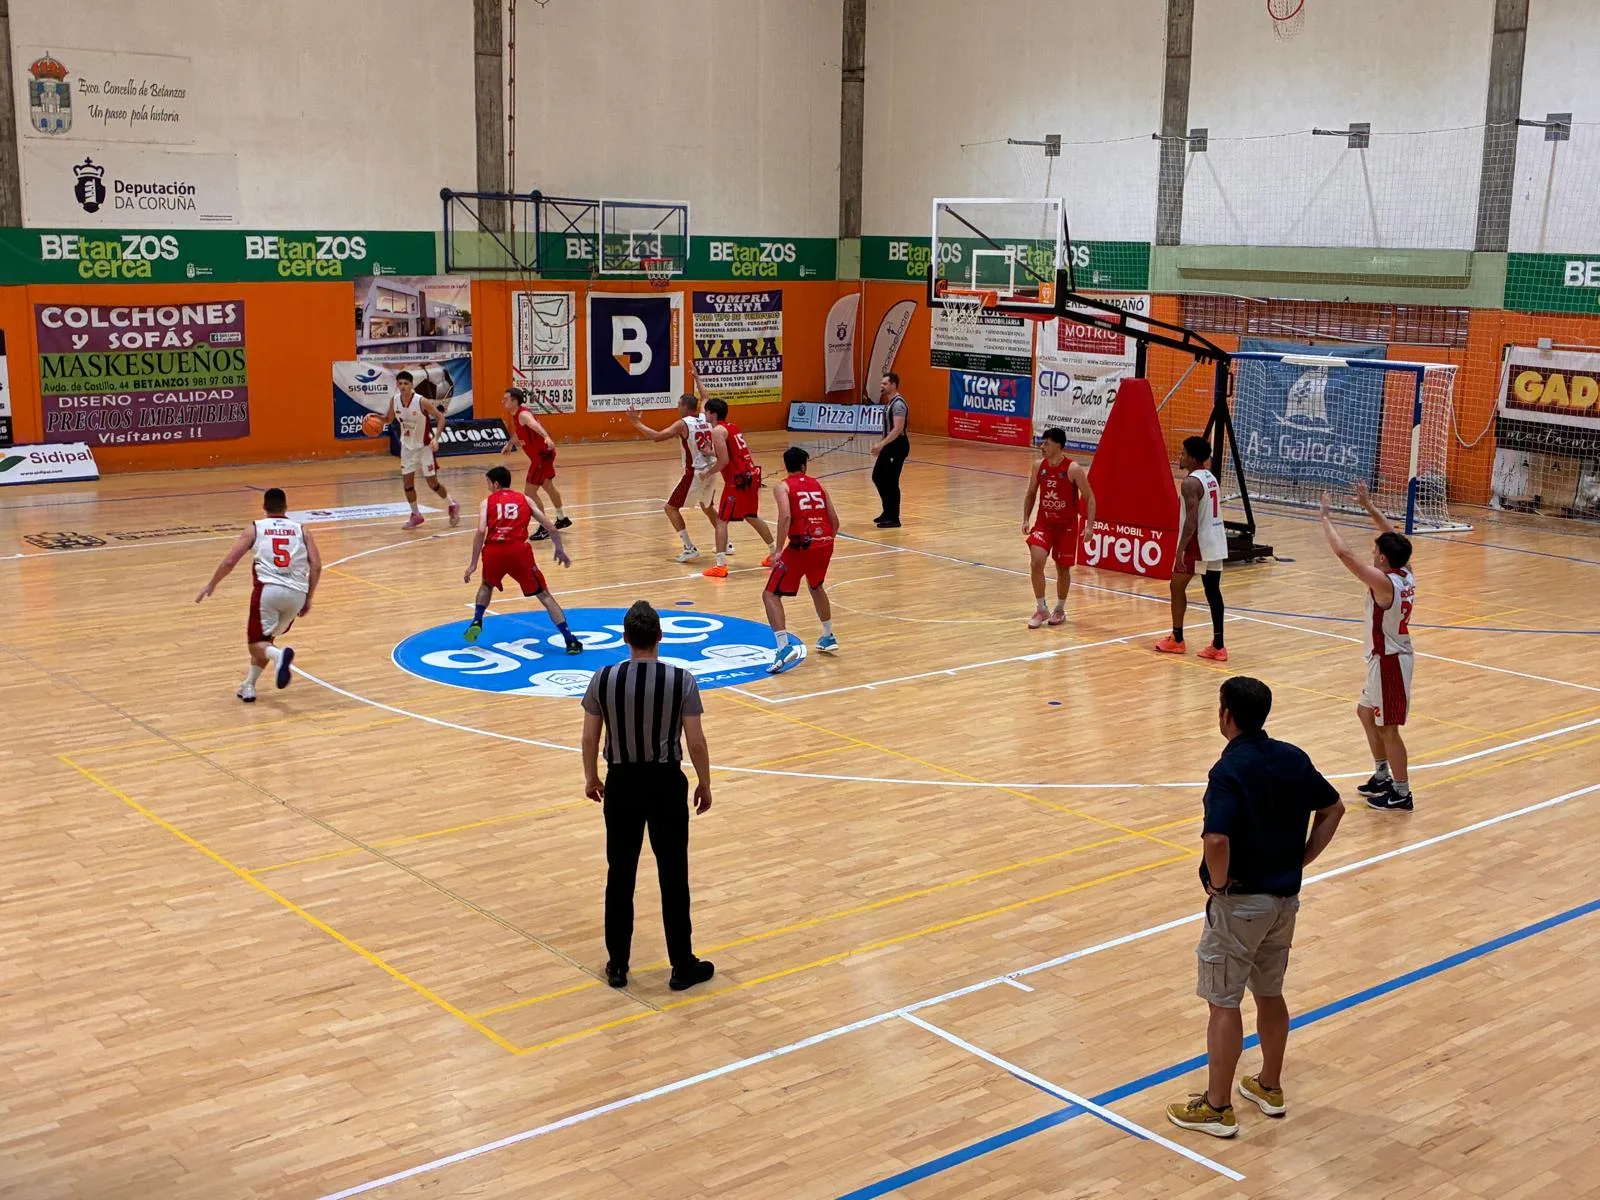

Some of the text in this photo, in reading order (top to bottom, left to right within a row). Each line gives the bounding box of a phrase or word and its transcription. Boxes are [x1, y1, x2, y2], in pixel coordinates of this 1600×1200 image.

[103, 79, 137, 97] Concello
[138, 80, 148, 97] de
[150, 83, 186, 99] Betanzos
[88, 104, 179, 128] Un paseo pola historia
[114, 180, 196, 198] Deputación
[114, 194, 197, 211] DA CORUÑA
[40, 234, 179, 261] BEtanZOS
[245, 235, 367, 260] BEtanZOS
[709, 241, 796, 263] BEtanZOS
[78, 259, 152, 279] cerca
[277, 259, 342, 277] cerca
[731, 260, 777, 277] cerca
[906, 259, 945, 277] cera
[705, 293, 770, 304] COMPRA
[714, 302, 762, 313] VENTA
[41, 303, 236, 328] COLCHONES
[71, 327, 194, 350] y SOFÁS
[1065, 323, 1118, 340] MOTRIO
[611, 315, 653, 376] B
[695, 337, 779, 359] VARA
[41, 344, 246, 380] MASKESUEÑOS
[527, 355, 559, 365] TUTTO
[695, 359, 737, 367] SERVICIOS
[698, 362, 778, 374] Y FORESTALES
[43, 382, 67, 393] Avda.
[71, 381, 82, 392] de
[119, 381, 129, 390] 44
[133, 377, 189, 390] BETANZOS
[192, 377, 207, 386] 981
[209, 377, 219, 386] 97
[222, 375, 234, 385] 08
[236, 374, 246, 384] 75
[546, 378, 573, 388] DOMICILIO
[1514, 370, 1600, 409] GAD
[58, 394, 132, 409] DISEÑO
[152, 389, 235, 405] CALIDAD
[549, 389, 560, 403] 59
[562, 389, 573, 403] 83
[962, 394, 1016, 412] MOLARES
[1071, 386, 1117, 408] Pedro P
[46, 401, 249, 434] PRECIOS IMBATIBLES
[817, 405, 854, 424] Pizza
[1047, 414, 1073, 423] REFORME
[1081, 417, 1096, 426] BAÑO
[98, 426, 203, 444] Visítanos !!
[733, 433, 748, 450] 15
[29, 448, 93, 465] Sidipal
[1246, 430, 1359, 466] As Galeras
[1047, 479, 1057, 488] 22
[797, 491, 826, 511] 25
[496, 503, 519, 520] 18
[1086, 520, 1110, 532] BRA
[1116, 525, 1144, 537] MOBIL
[1150, 530, 1163, 540] TV
[272, 537, 291, 568] 5
[1084, 533, 1162, 574] grelo
